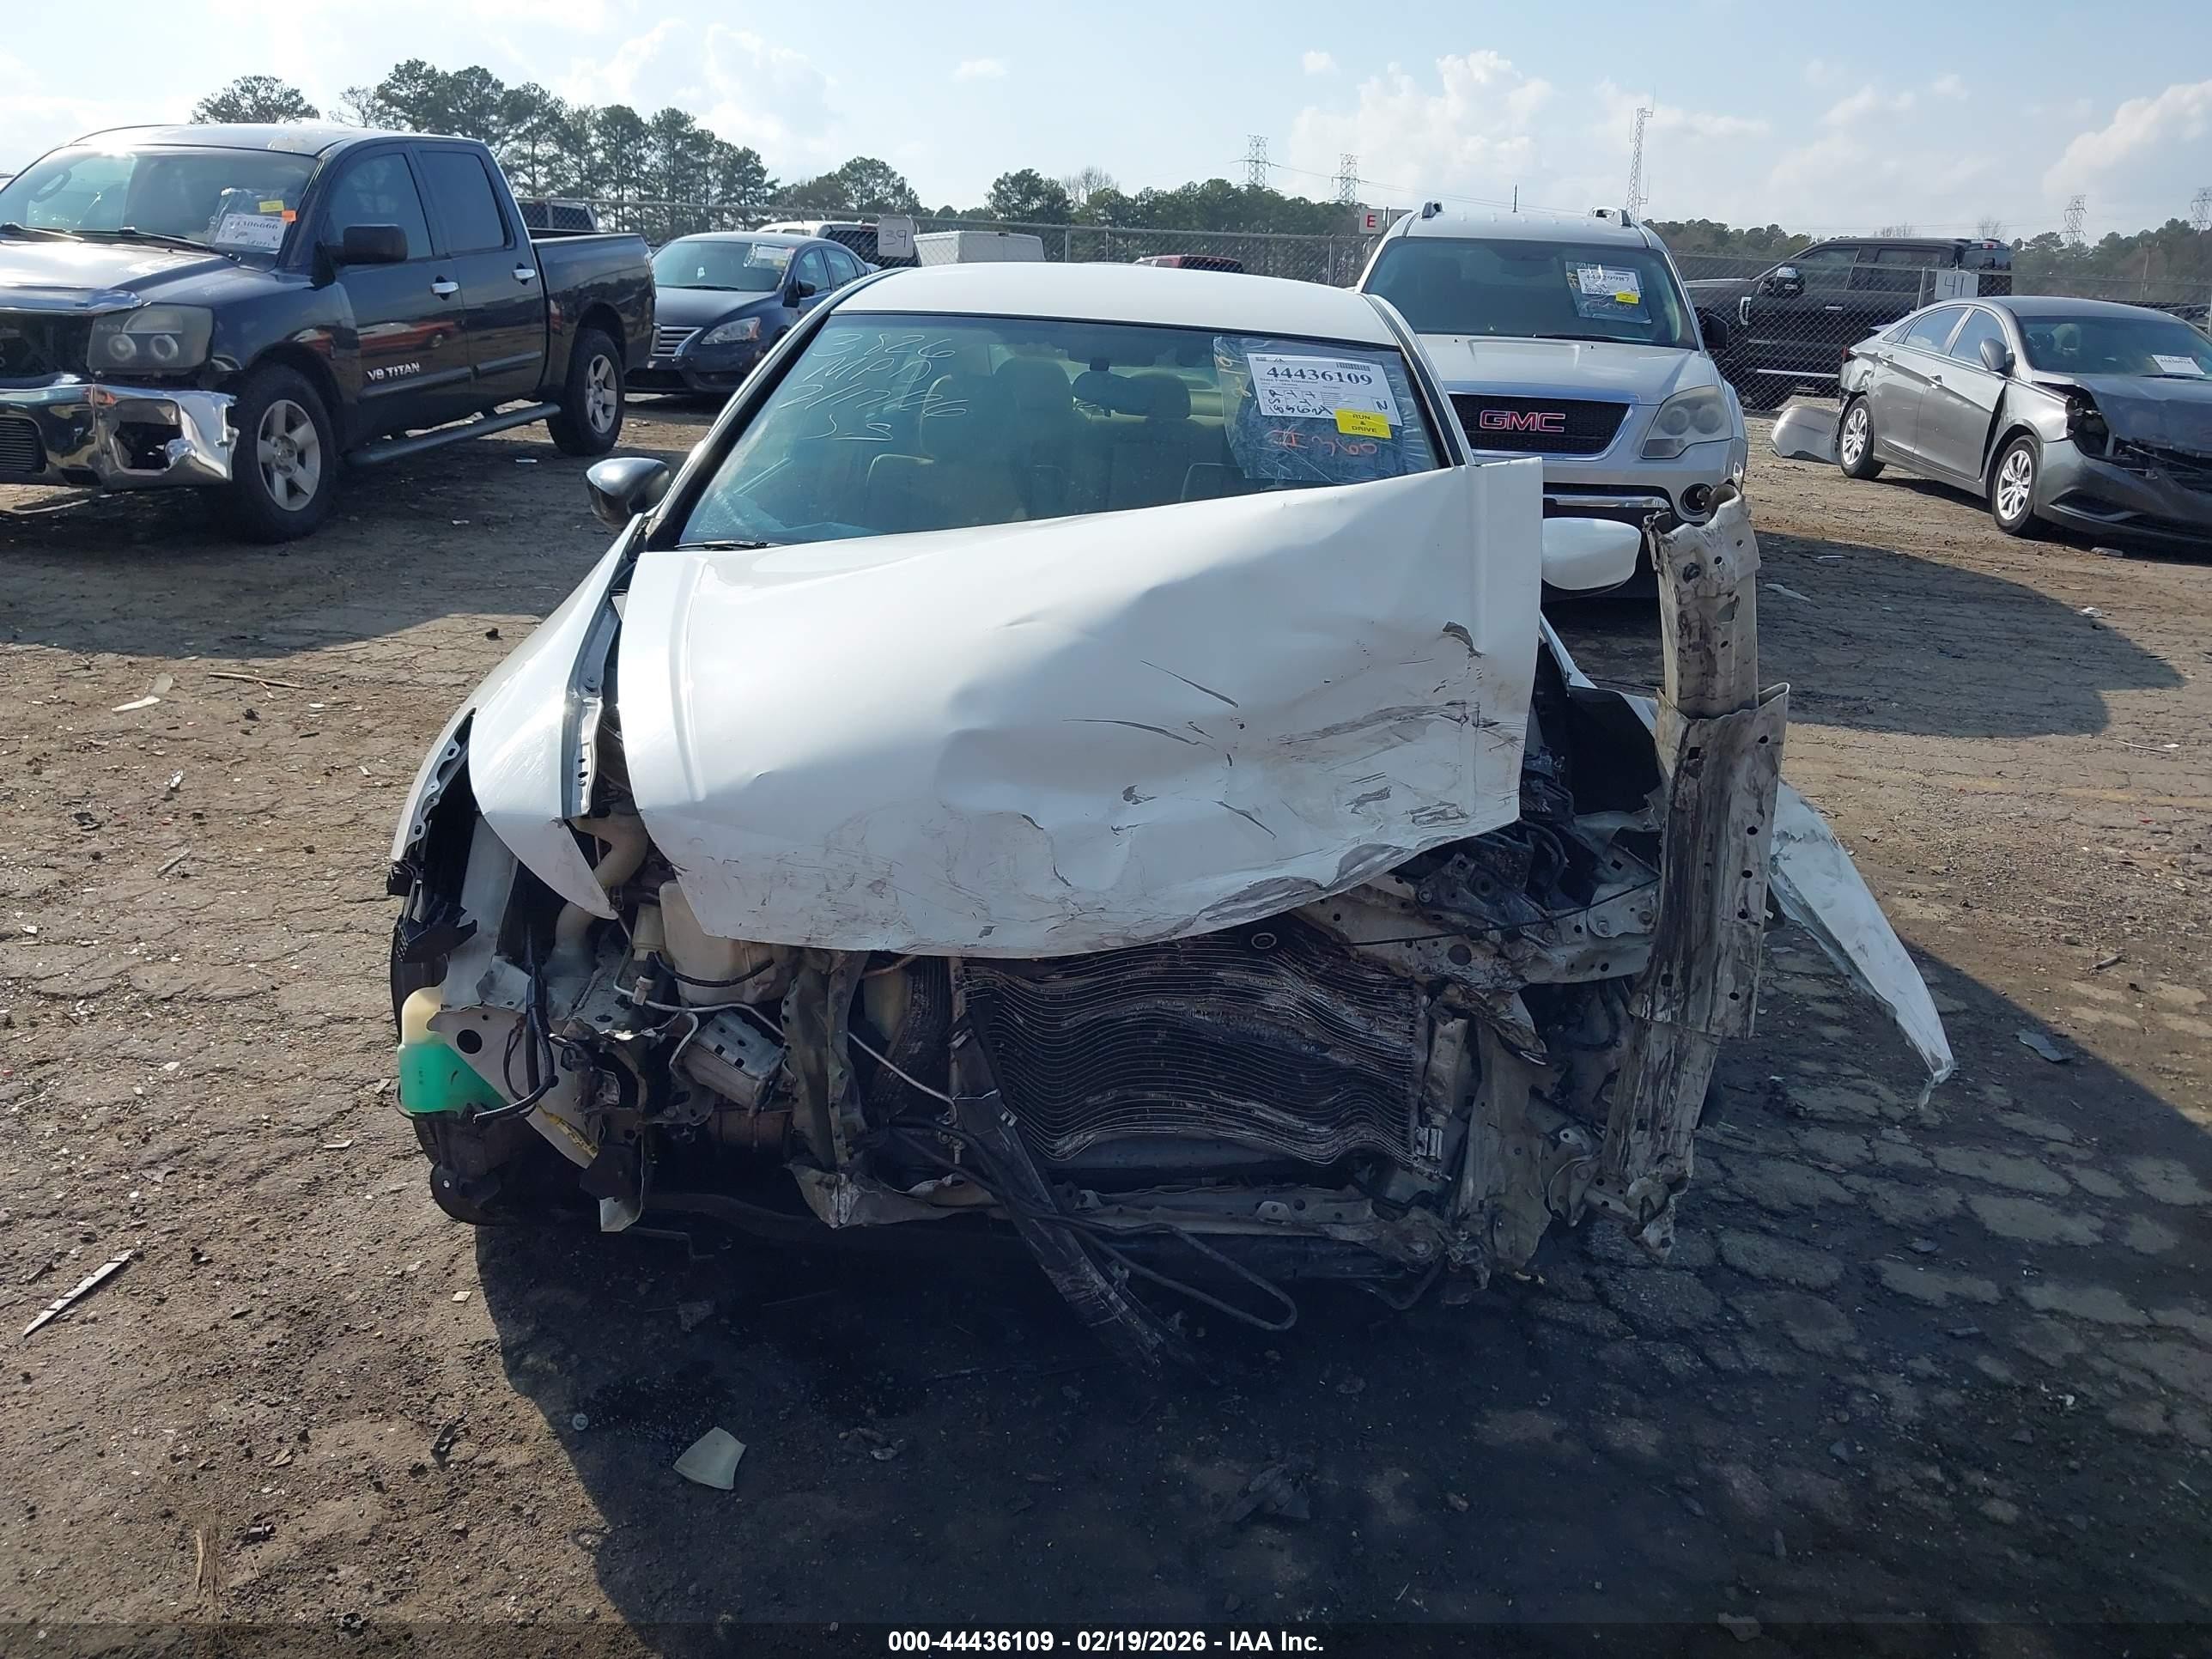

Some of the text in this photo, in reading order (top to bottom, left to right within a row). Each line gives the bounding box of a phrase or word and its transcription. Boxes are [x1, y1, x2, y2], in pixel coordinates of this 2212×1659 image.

[1366, 215, 1377, 228] E
[882, 228, 908, 248] 39
[1944, 275, 1965, 296] 41
[367, 362, 420, 380] V8 TITAN
[1267, 366, 1373, 386] 44436109
[1352, 425, 1377, 434] DRIVE
[1480, 410, 1565, 433] GMC
